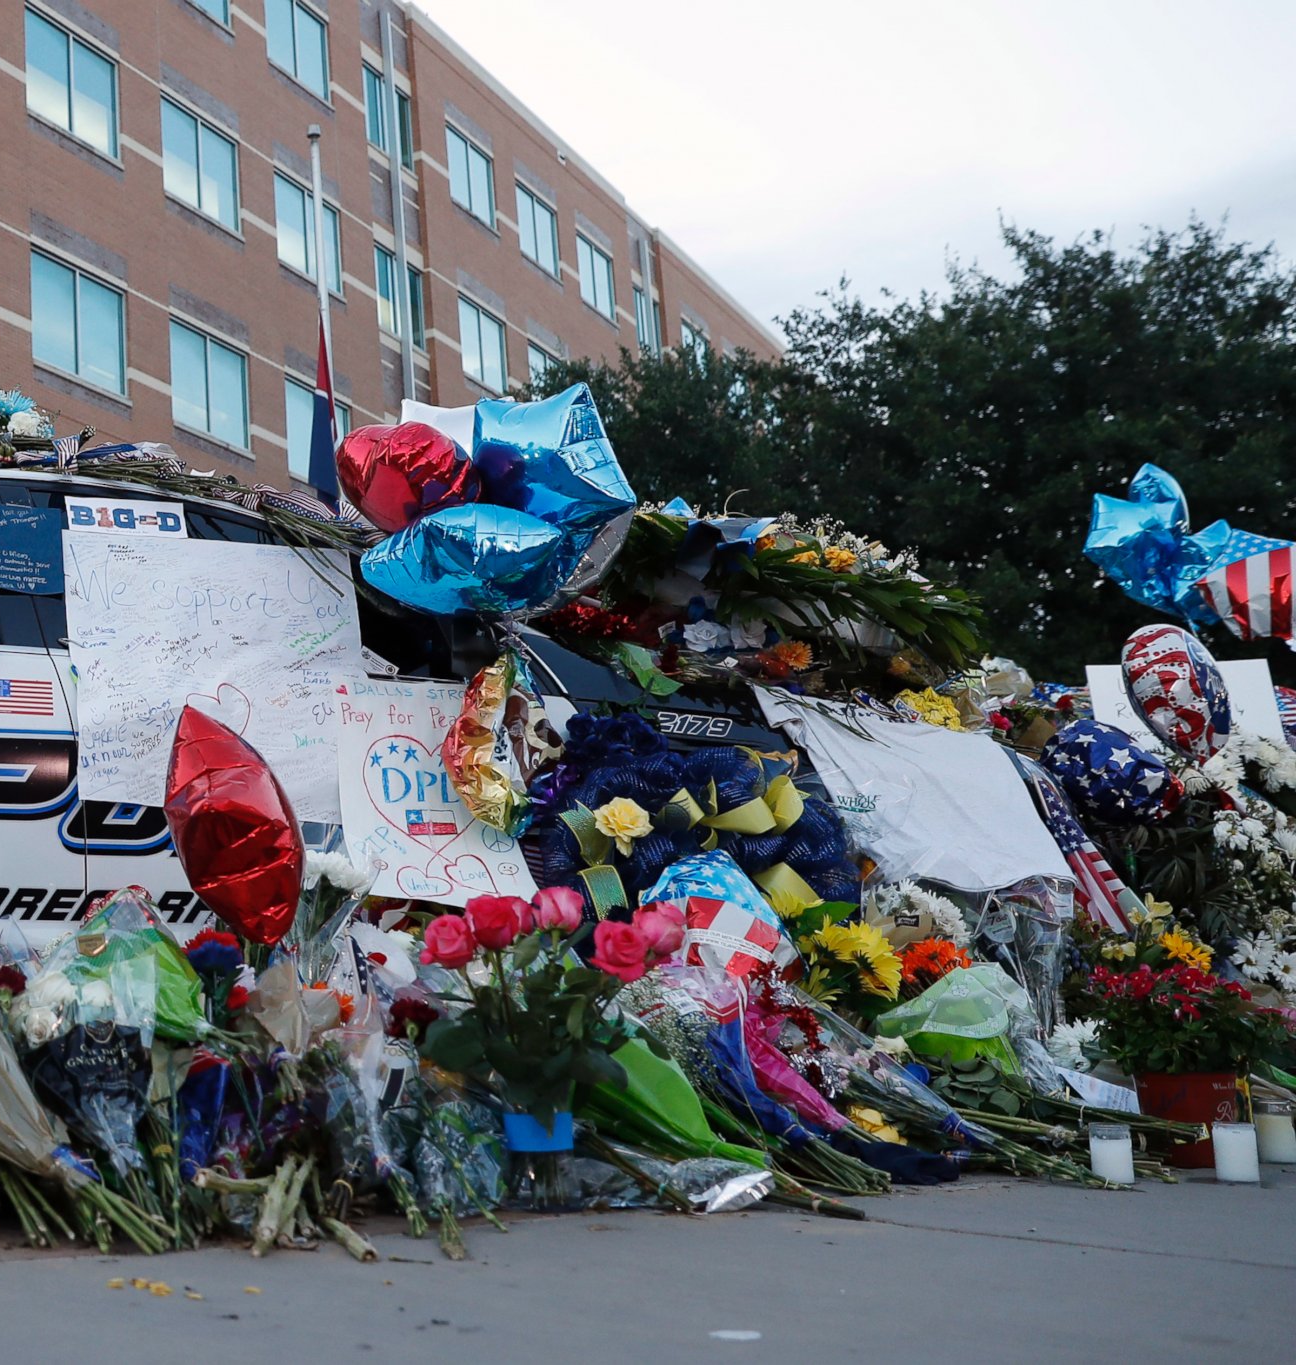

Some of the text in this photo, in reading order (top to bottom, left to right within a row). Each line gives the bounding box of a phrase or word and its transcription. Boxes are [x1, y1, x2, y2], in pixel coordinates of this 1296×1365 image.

[70, 544, 136, 610] We
[354, 682, 414, 697] DALLAS
[340, 702, 459, 733] Pray for Pea
[657, 711, 733, 738] 2179
